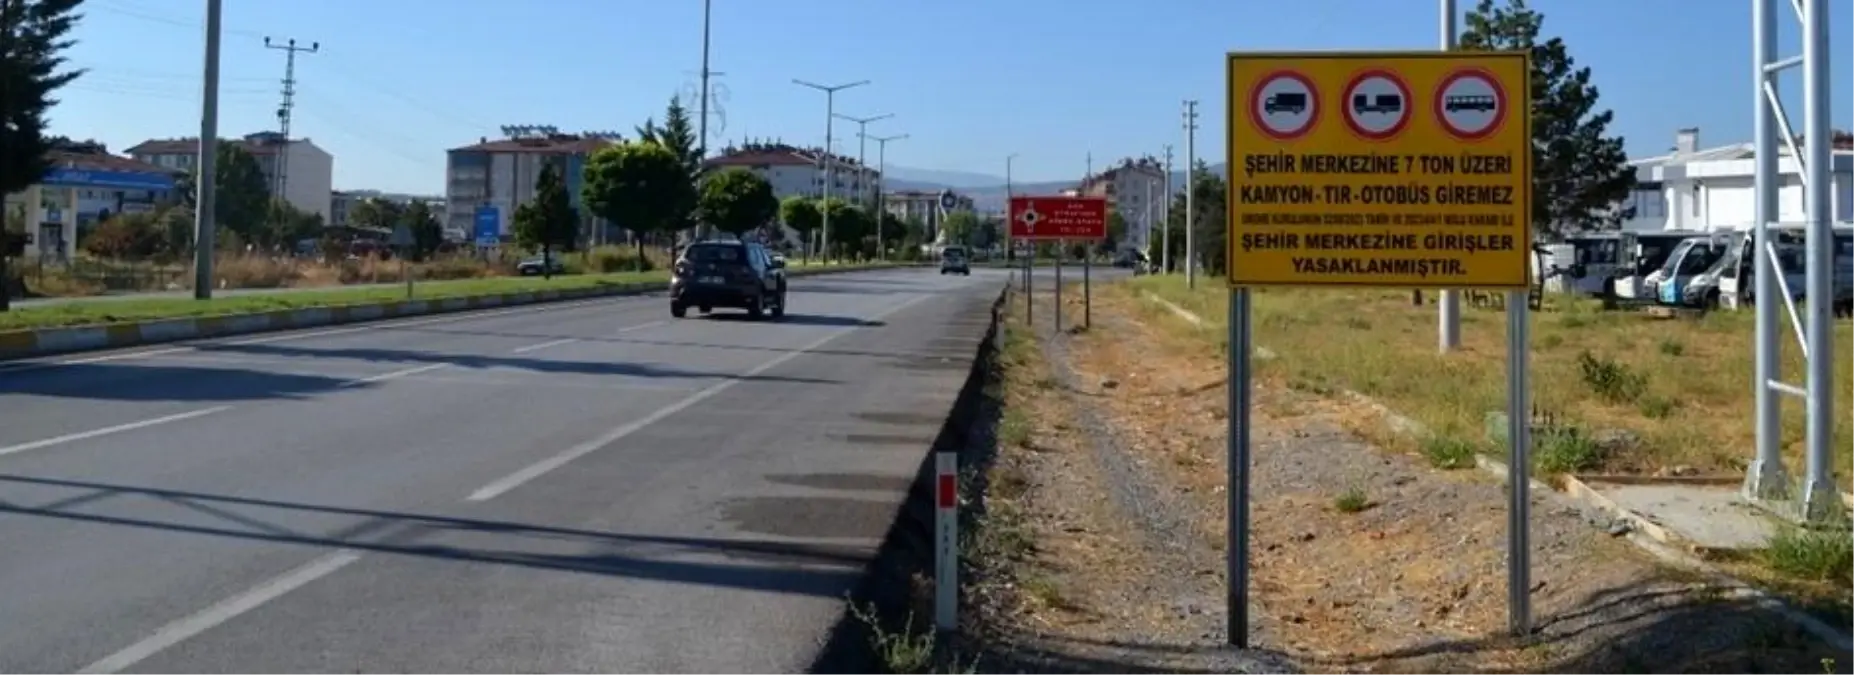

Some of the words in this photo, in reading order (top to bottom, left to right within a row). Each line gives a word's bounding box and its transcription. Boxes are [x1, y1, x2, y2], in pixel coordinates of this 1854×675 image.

[1245, 149, 1296, 178] ŞEHİR
[1301, 150, 1399, 174] MERKEZİNE
[1404, 155, 1415, 173] 7
[1419, 155, 1454, 174] TON
[1460, 149, 1513, 174] ÜZERİ
[1435, 181, 1514, 206] GİREMEZ
[1242, 229, 1299, 253] ŞEHİR
[1304, 230, 1418, 250] MERKEZİNE
[1423, 229, 1514, 256] GİRİŞLER
[1291, 257, 1468, 278] YASAKLANMIŞTIR.
